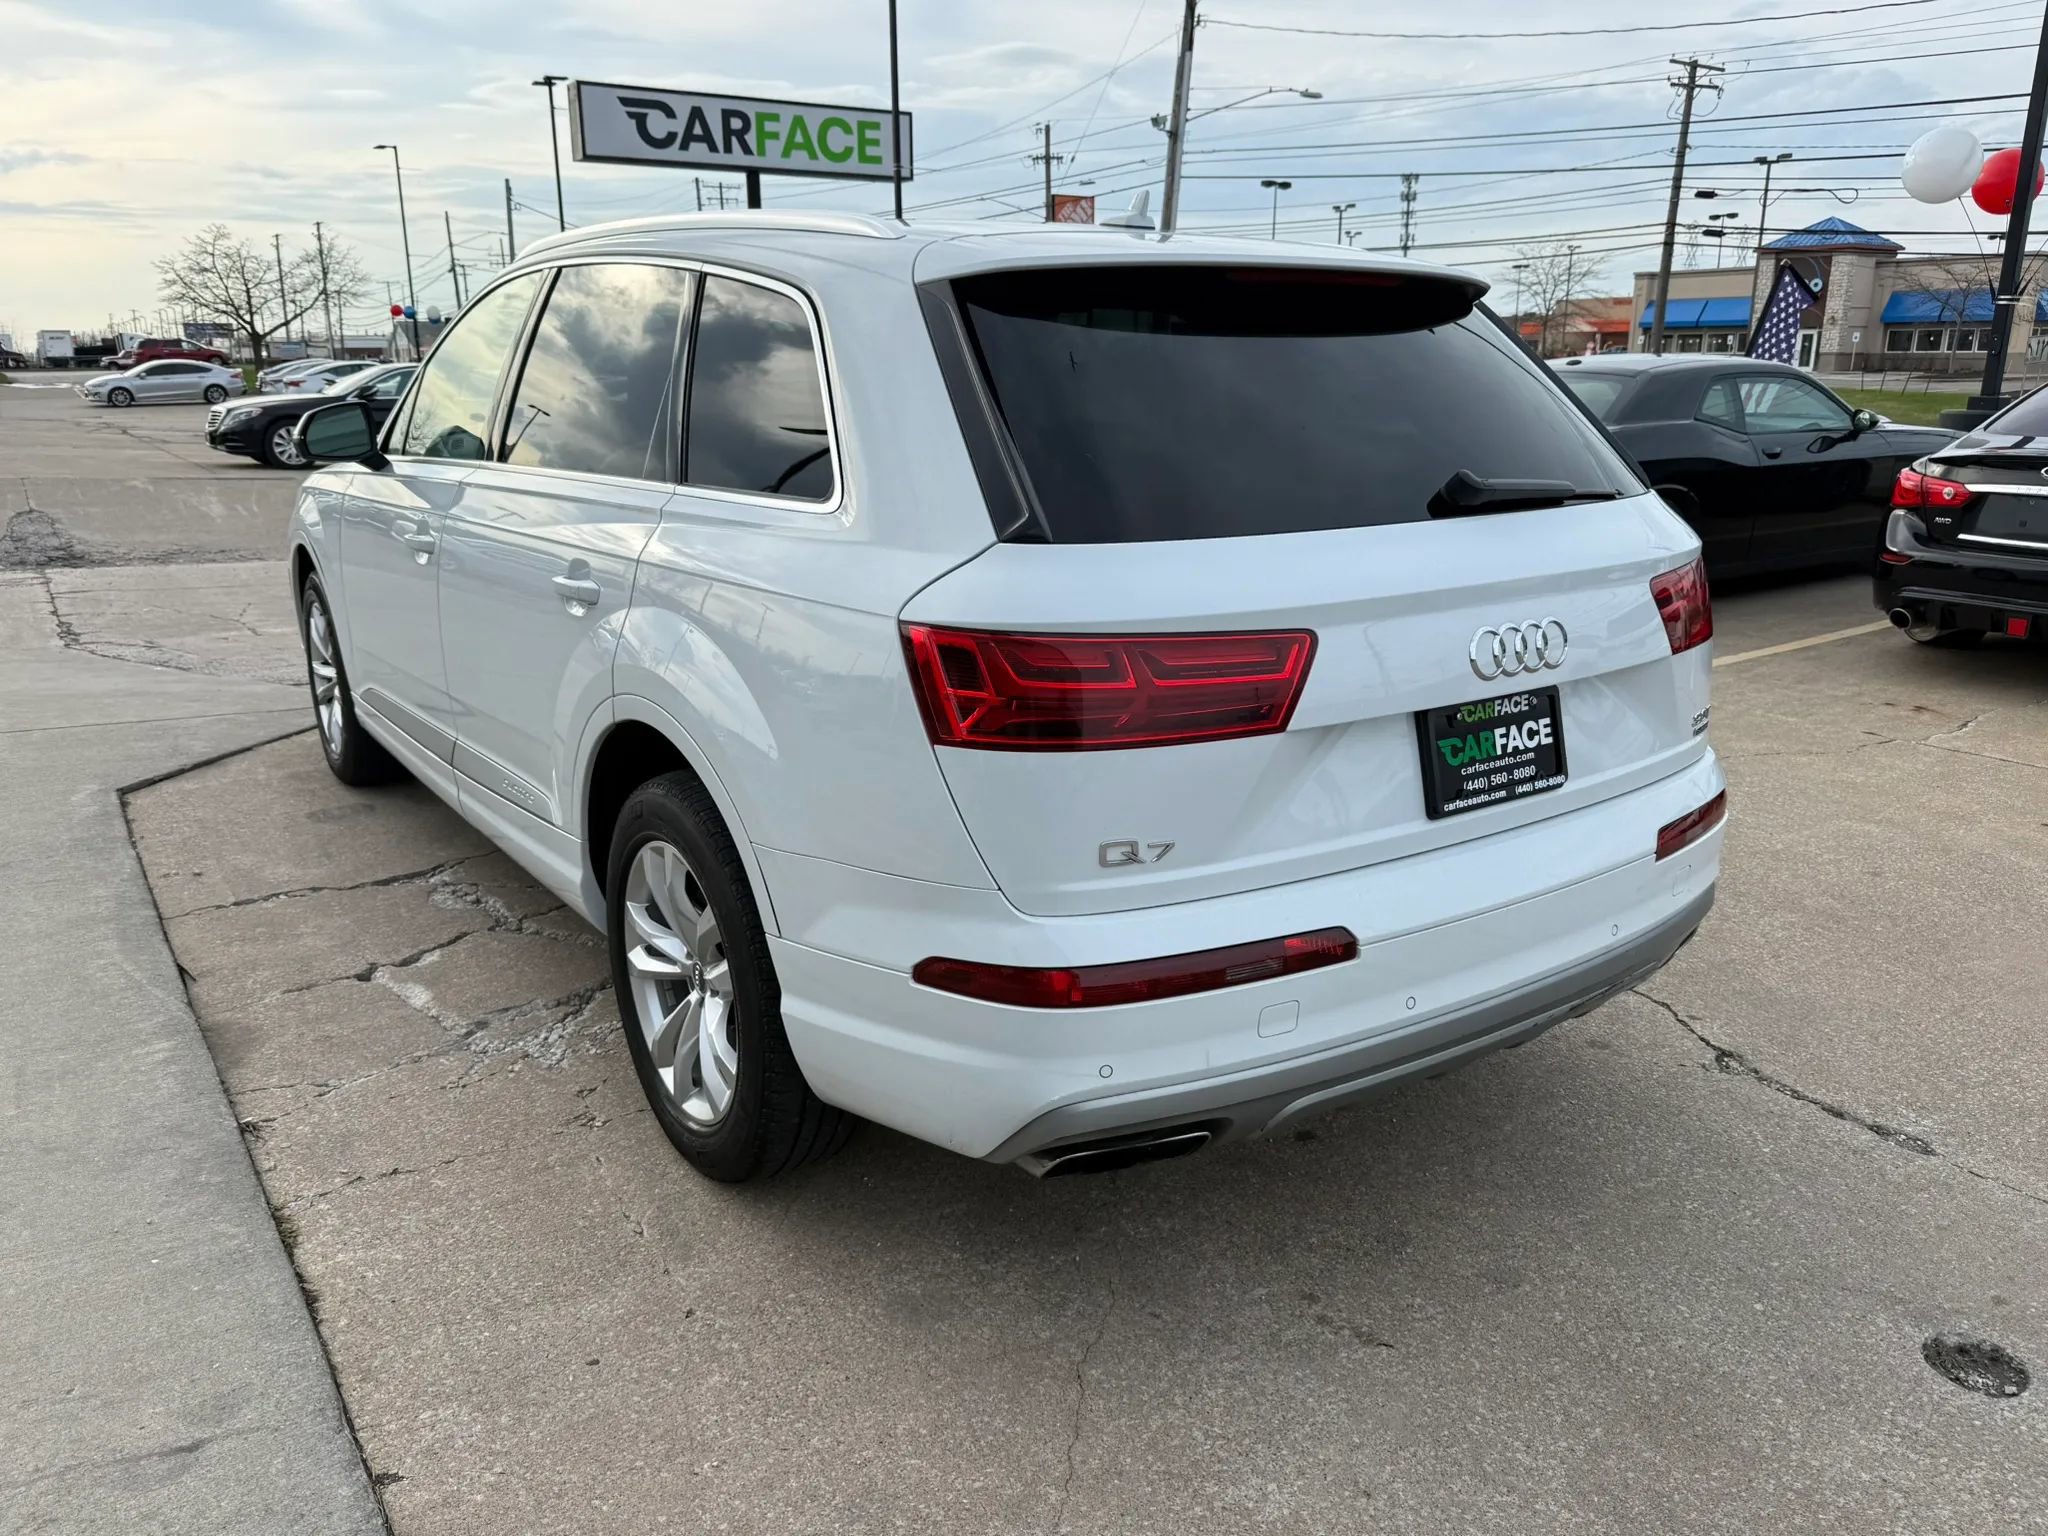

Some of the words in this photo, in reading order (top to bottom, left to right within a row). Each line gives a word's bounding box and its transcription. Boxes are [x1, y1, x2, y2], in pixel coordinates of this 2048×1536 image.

[616, 96, 884, 165] CARFACE
[1460, 693, 1530, 723] CARFACE
[1437, 717, 1553, 767] CARFACE
[1461, 752, 1535, 776] carfaceauto.com
[1443, 789, 1507, 812] carfaceauto.com
[1515, 782, 1534, 796] (440)
[1534, 775, 1566, 789] 560-8080
[1463, 776, 1488, 792] (440)
[1098, 839, 1175, 868] Q7
